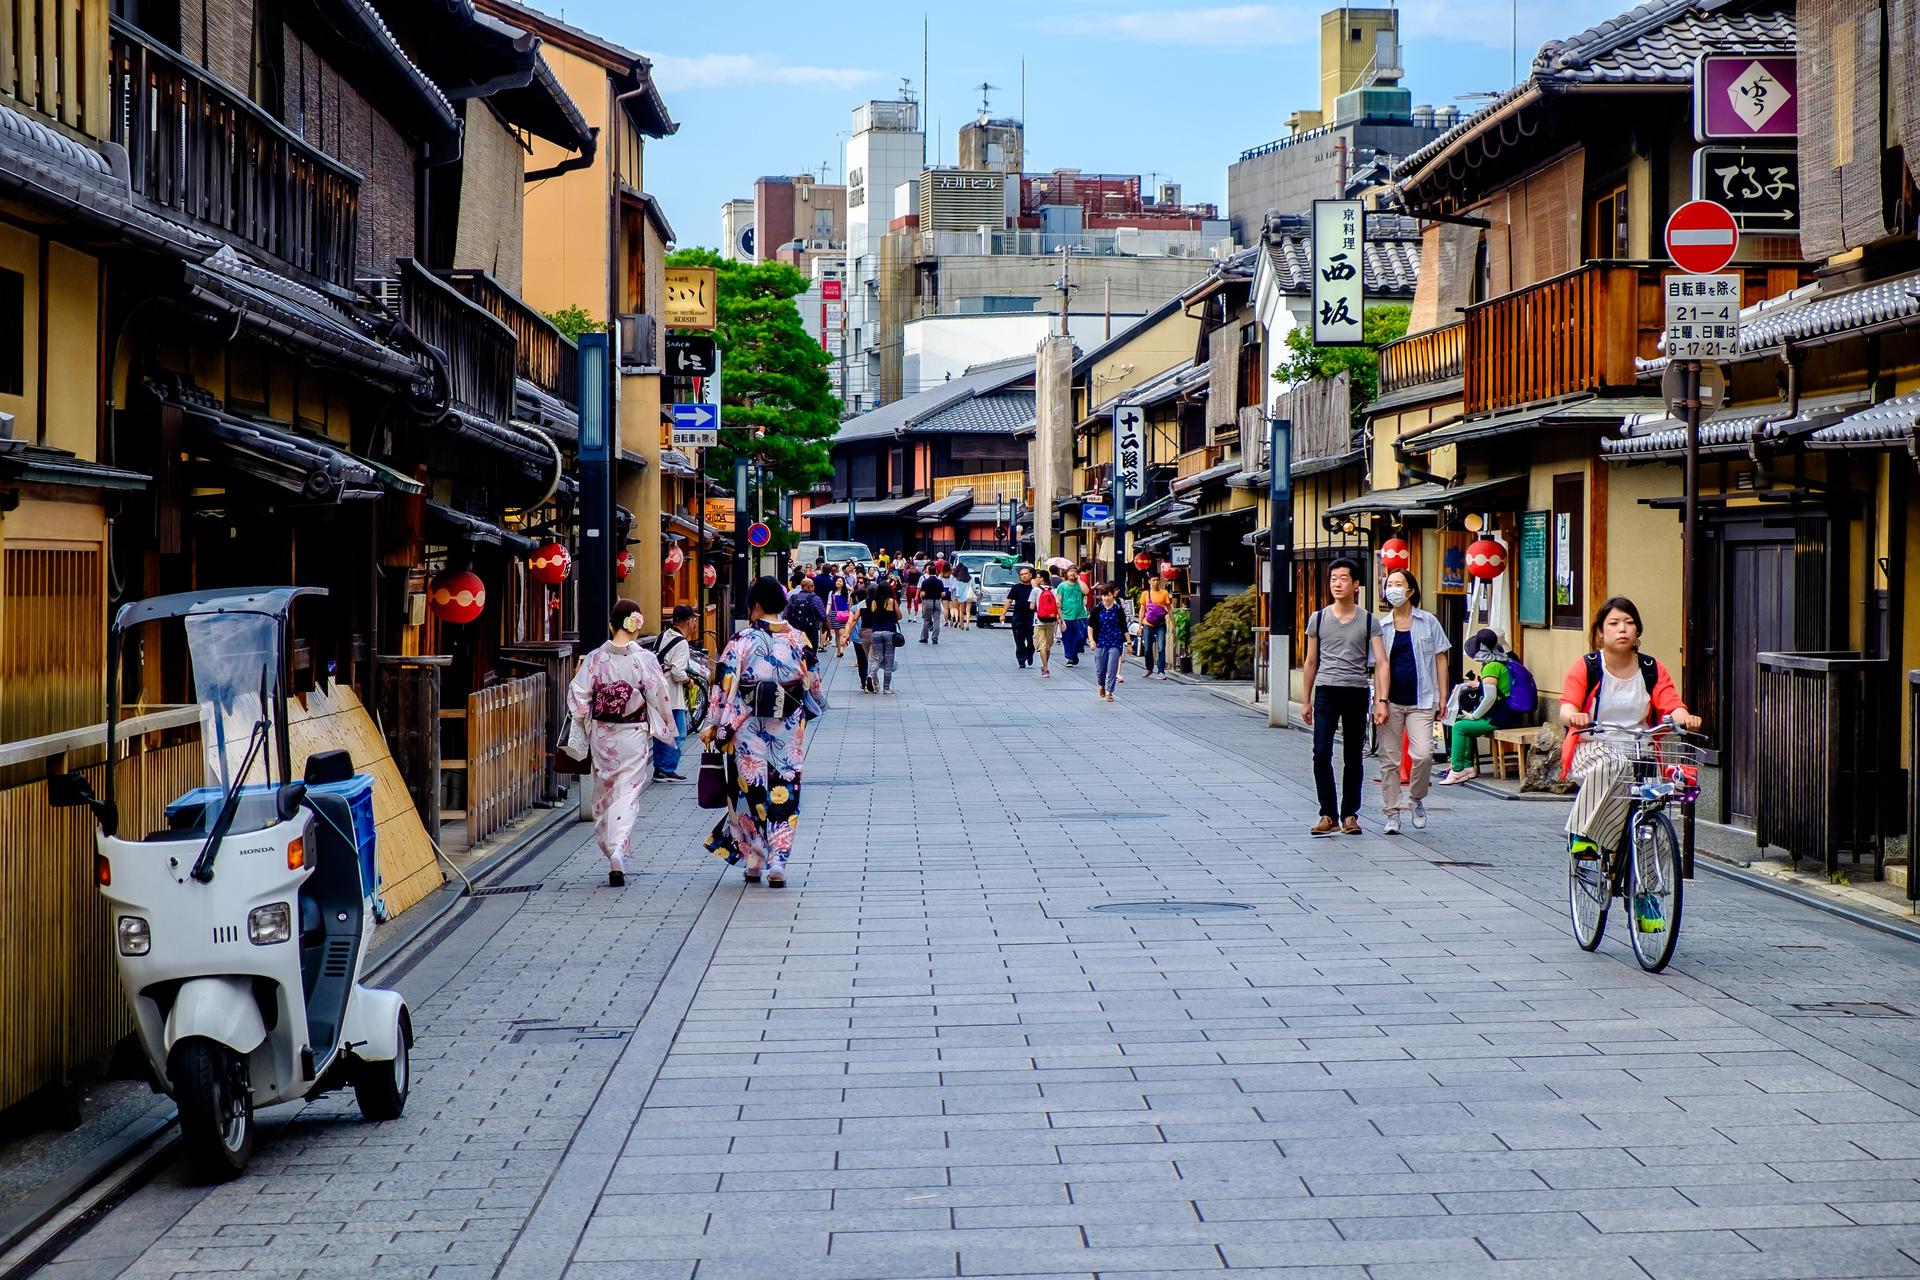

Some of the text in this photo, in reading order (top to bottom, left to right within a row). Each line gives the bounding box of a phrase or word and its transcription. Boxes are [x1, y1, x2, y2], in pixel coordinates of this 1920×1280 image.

[1714, 165, 1796, 200] てる子
[1343, 208, 1355, 250] 京料理
[669, 279, 705, 308] こいし
[1320, 253, 1359, 326] 西坂
[1669, 281, 1737, 296] 自転車を除く
[1669, 325, 1737, 339] 土曜、日曜は
[673, 433, 715, 443] 自転車を除く
[240, 846, 275, 855] HONDA
